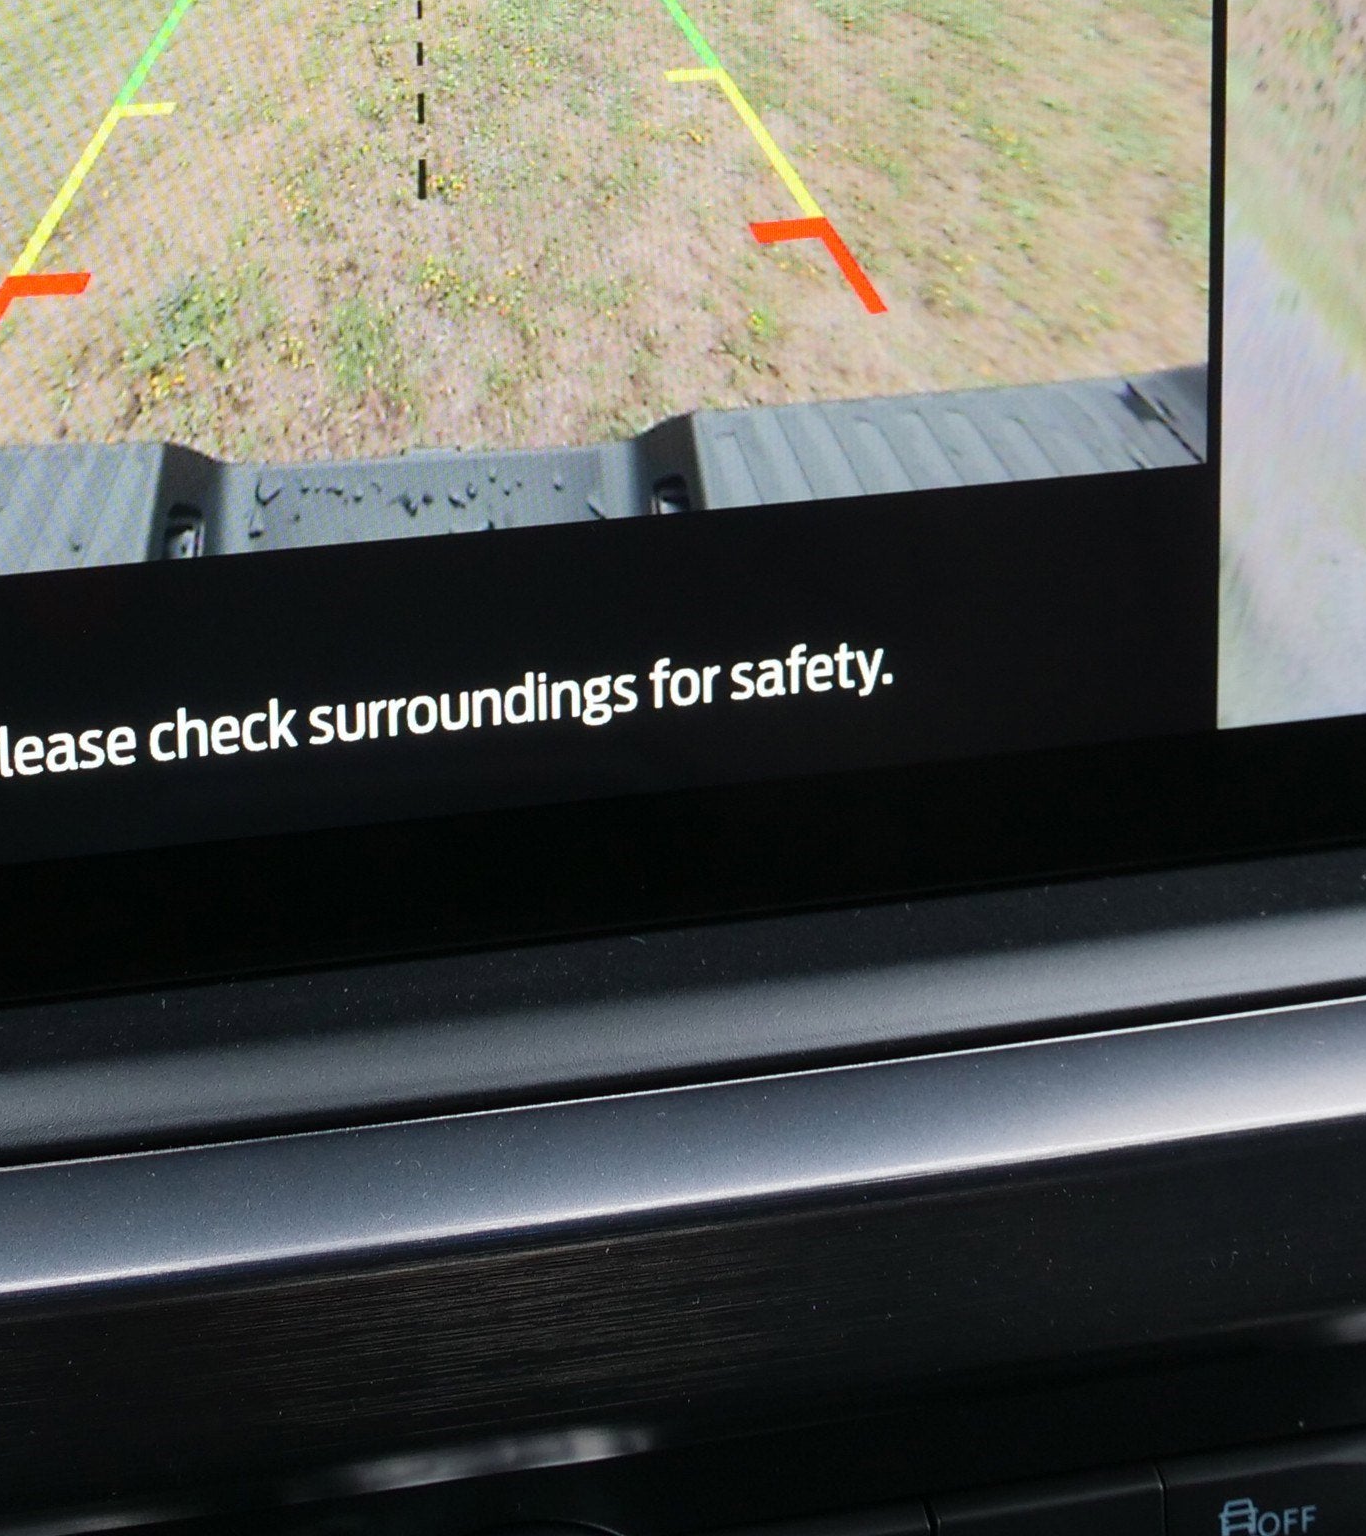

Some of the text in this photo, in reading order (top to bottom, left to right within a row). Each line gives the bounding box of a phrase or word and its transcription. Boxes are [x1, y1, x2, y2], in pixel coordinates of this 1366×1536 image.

[148, 696, 299, 762] check
[307, 670, 639, 745] surroundings
[648, 656, 721, 709] for
[730, 641, 894, 701] safety.
[1257, 1505, 1317, 1536] OFF
